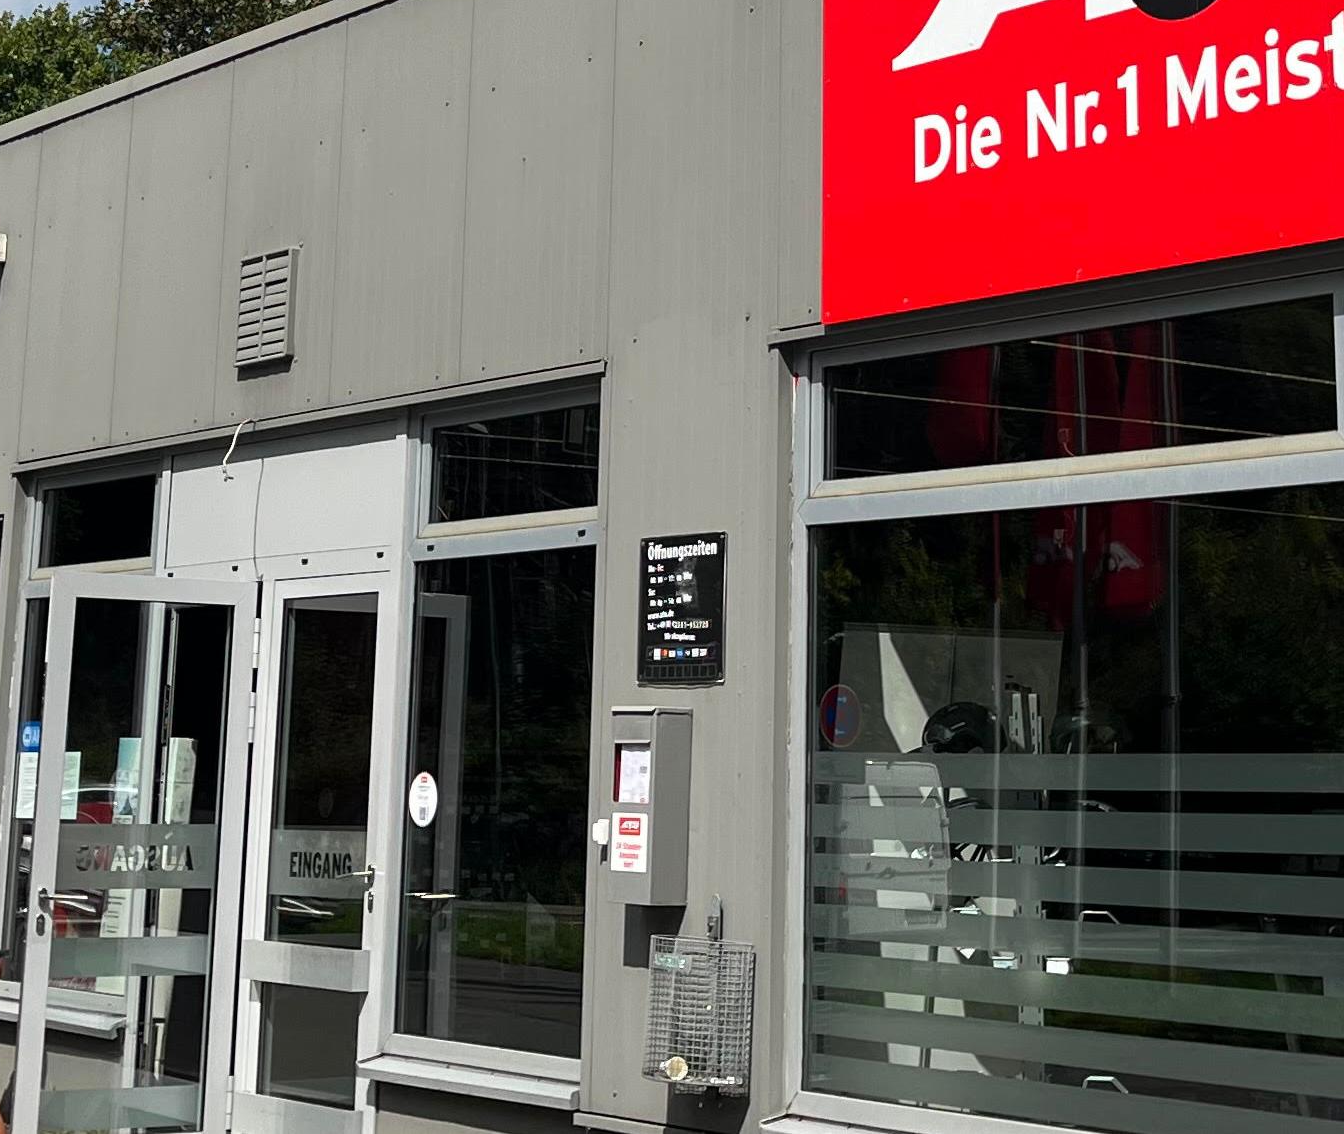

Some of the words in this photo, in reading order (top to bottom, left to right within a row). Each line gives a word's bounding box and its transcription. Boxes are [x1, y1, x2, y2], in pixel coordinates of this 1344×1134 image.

[914, 104, 1002, 183] Die
[647, 539, 718, 562] Öffnungszeiten
[288, 850, 353, 880] EINGANG
